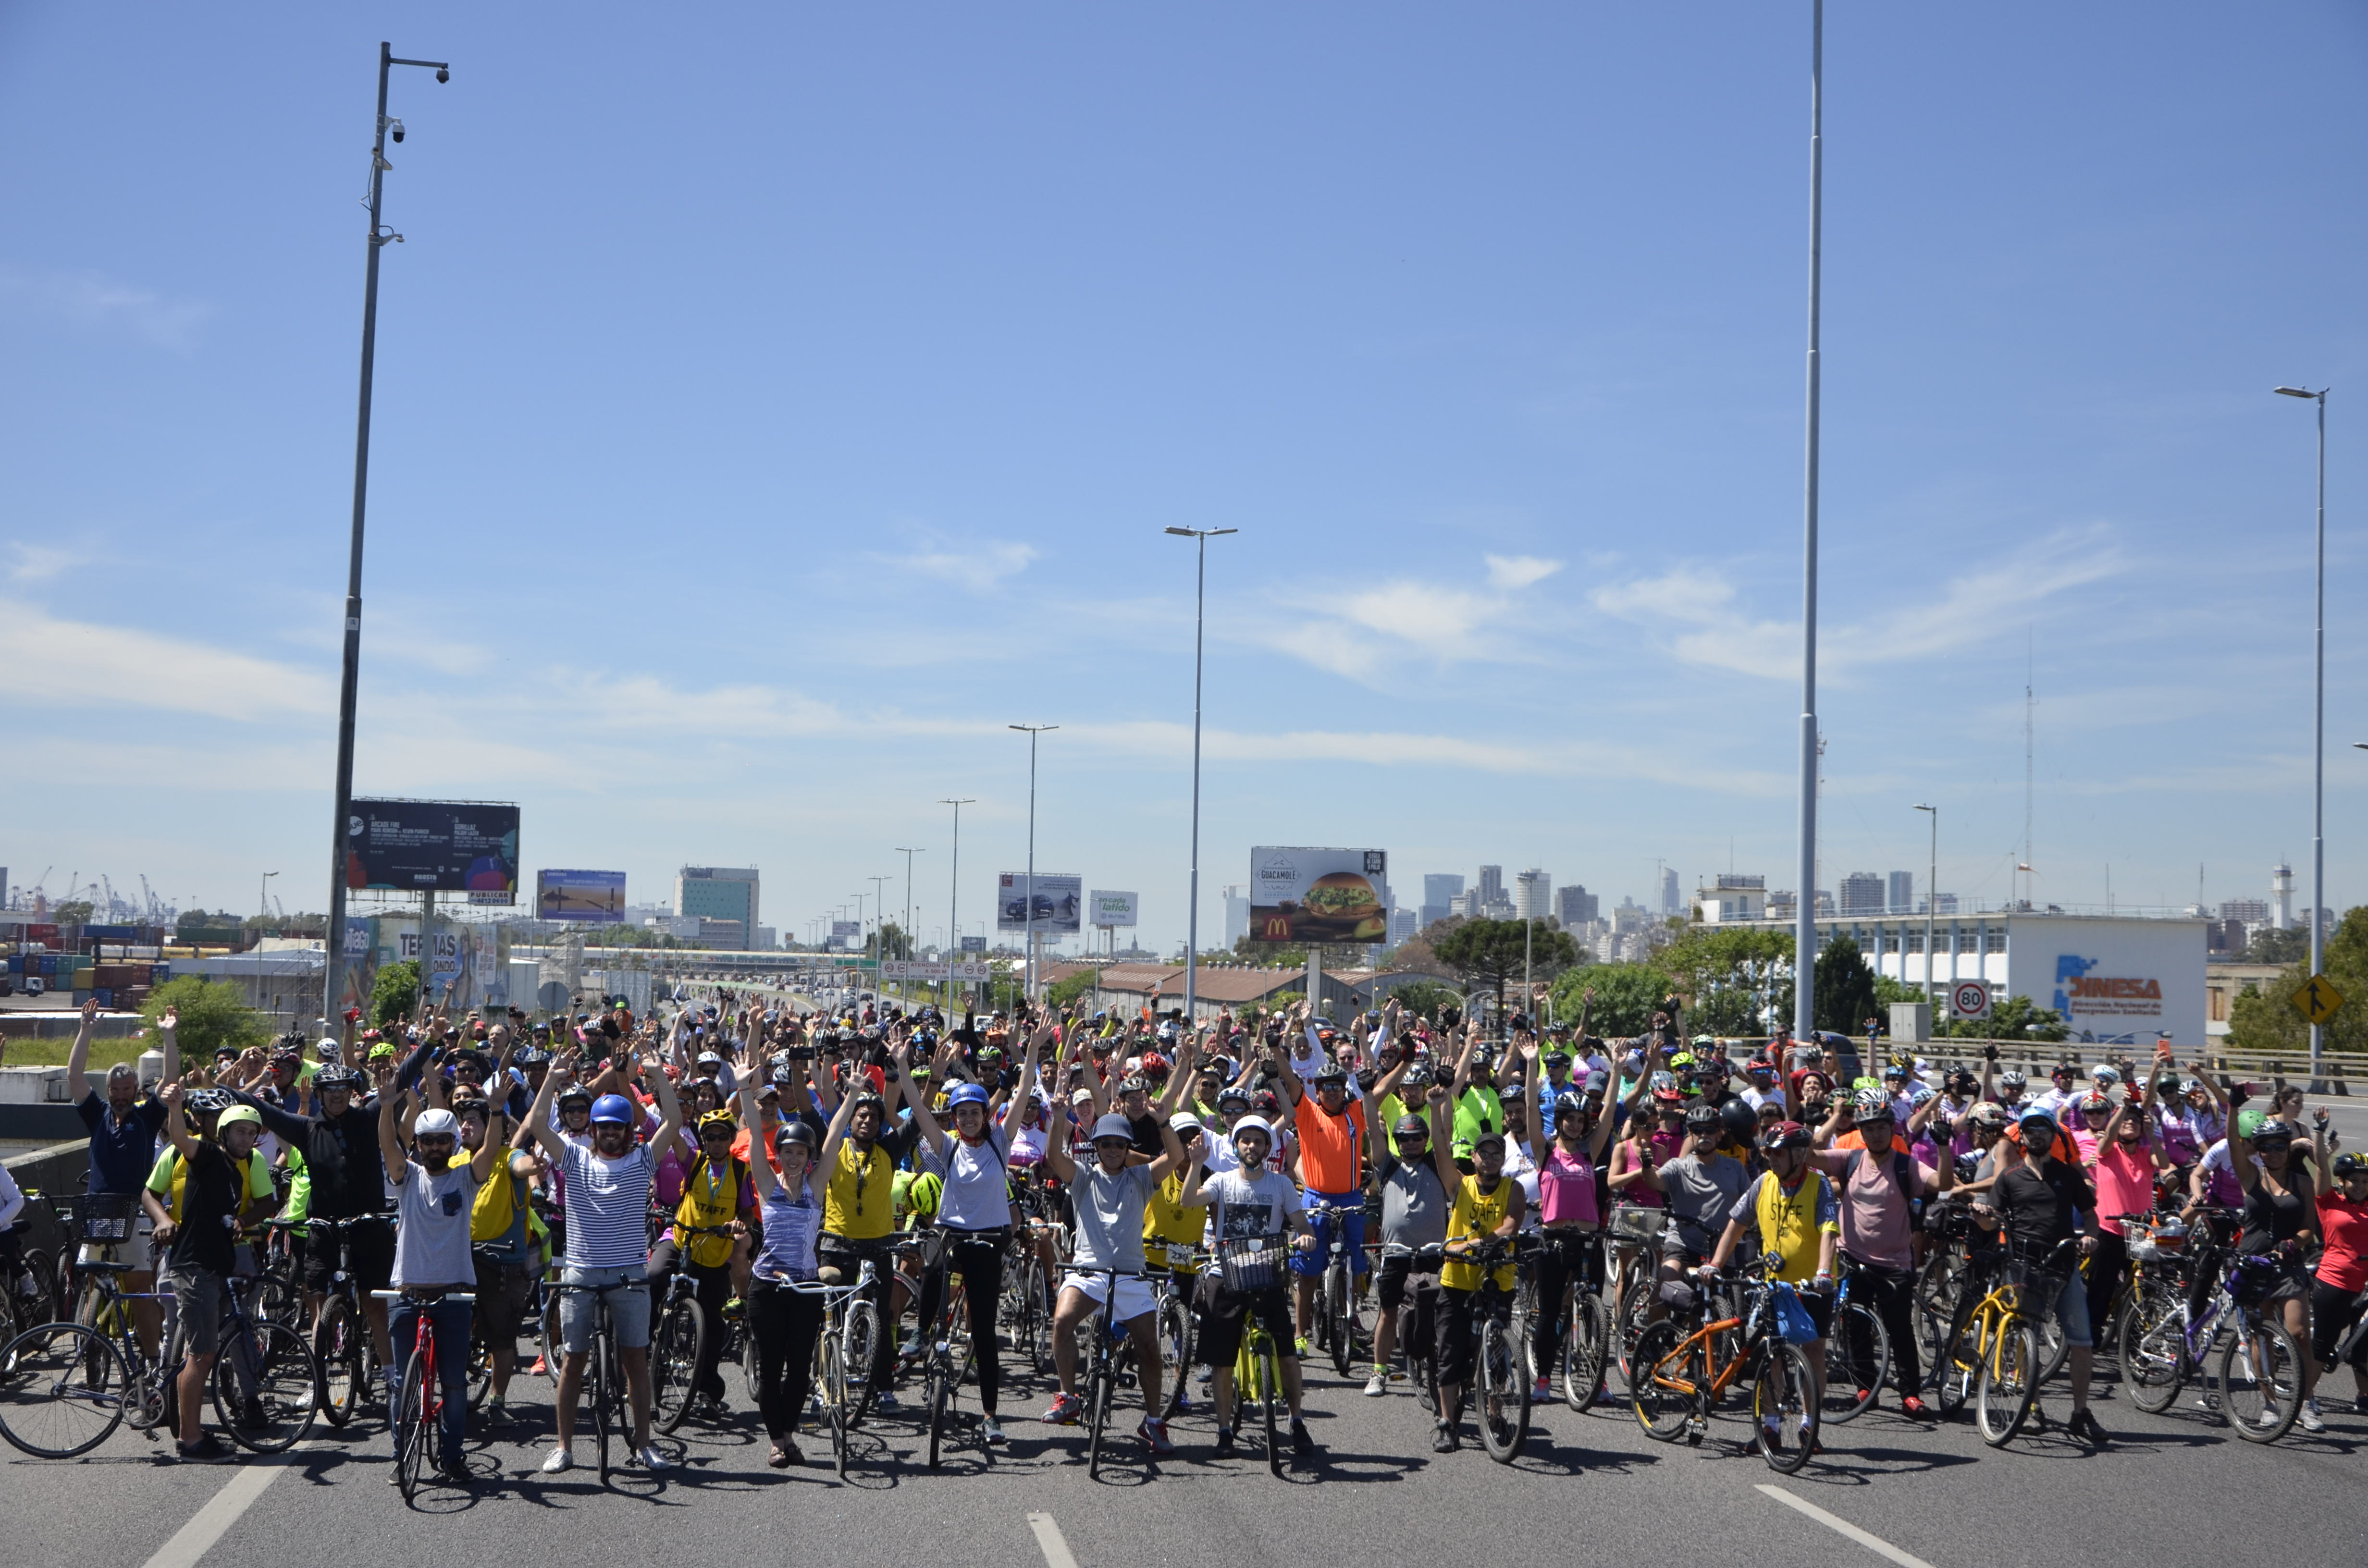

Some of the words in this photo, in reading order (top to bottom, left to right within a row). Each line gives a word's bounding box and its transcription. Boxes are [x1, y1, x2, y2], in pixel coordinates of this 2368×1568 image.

[350, 820, 363, 829] ue
[1261, 870, 1296, 880] GUACAMOLE
[1103, 903, 1130, 911] latido
[433, 960, 455, 972] ONDO
[1961, 992, 1980, 1005] 80
[1074, 1141, 1095, 1150] BICICL
[1074, 1152, 1100, 1163] BUSA
[695, 1201, 727, 1216] STAFF
[1469, 1202, 1500, 1221] STAFF
